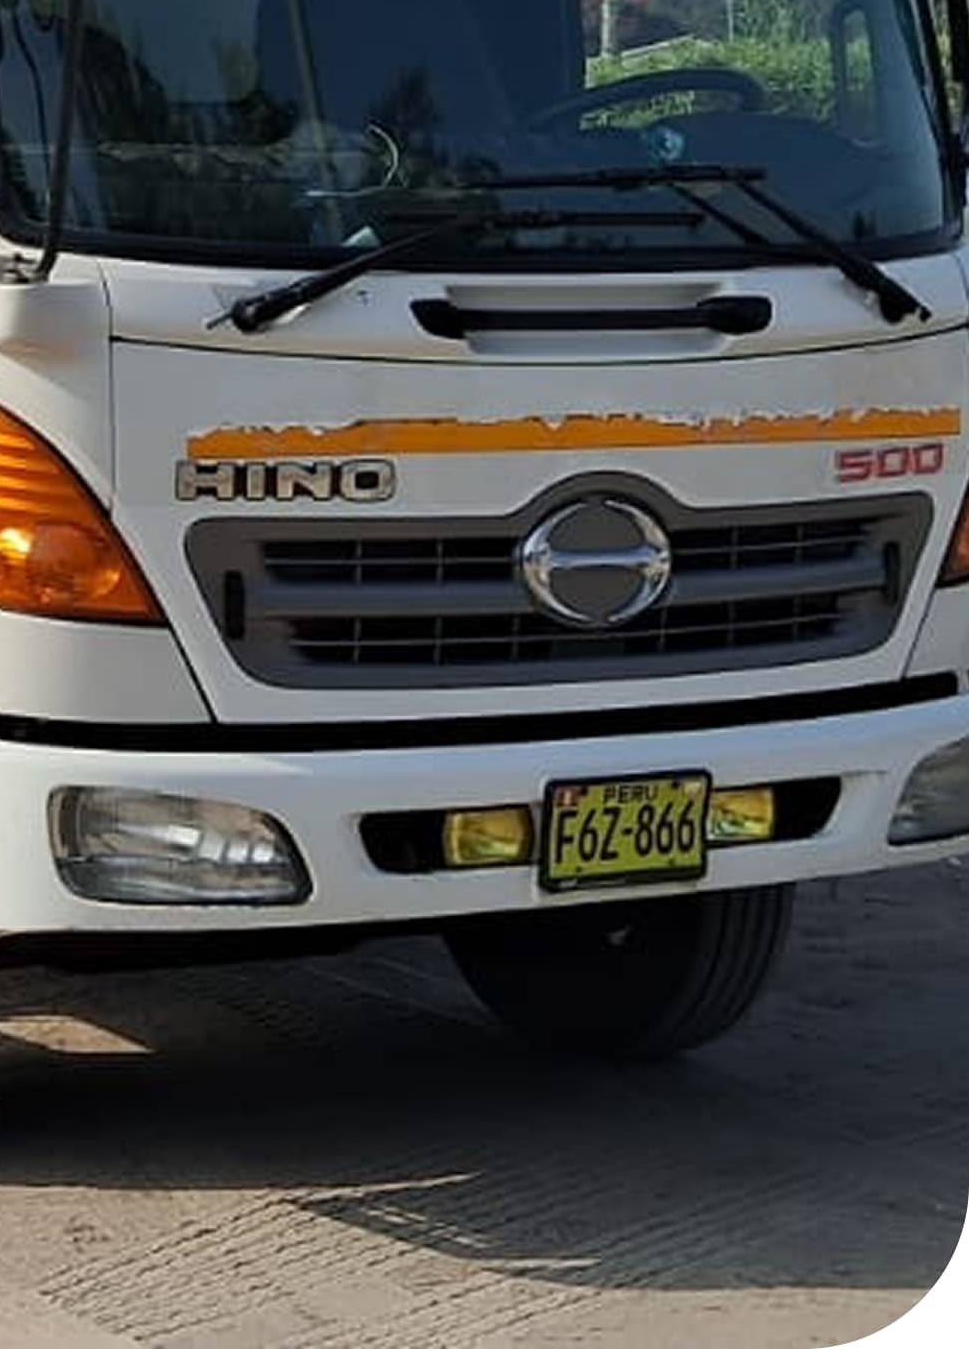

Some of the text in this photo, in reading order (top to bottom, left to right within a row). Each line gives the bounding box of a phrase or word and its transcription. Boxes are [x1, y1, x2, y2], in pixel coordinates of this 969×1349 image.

[176, 460, 396, 502] HINO
[834, 443, 944, 483] 500
[555, 802, 695, 864] F6Z-866
